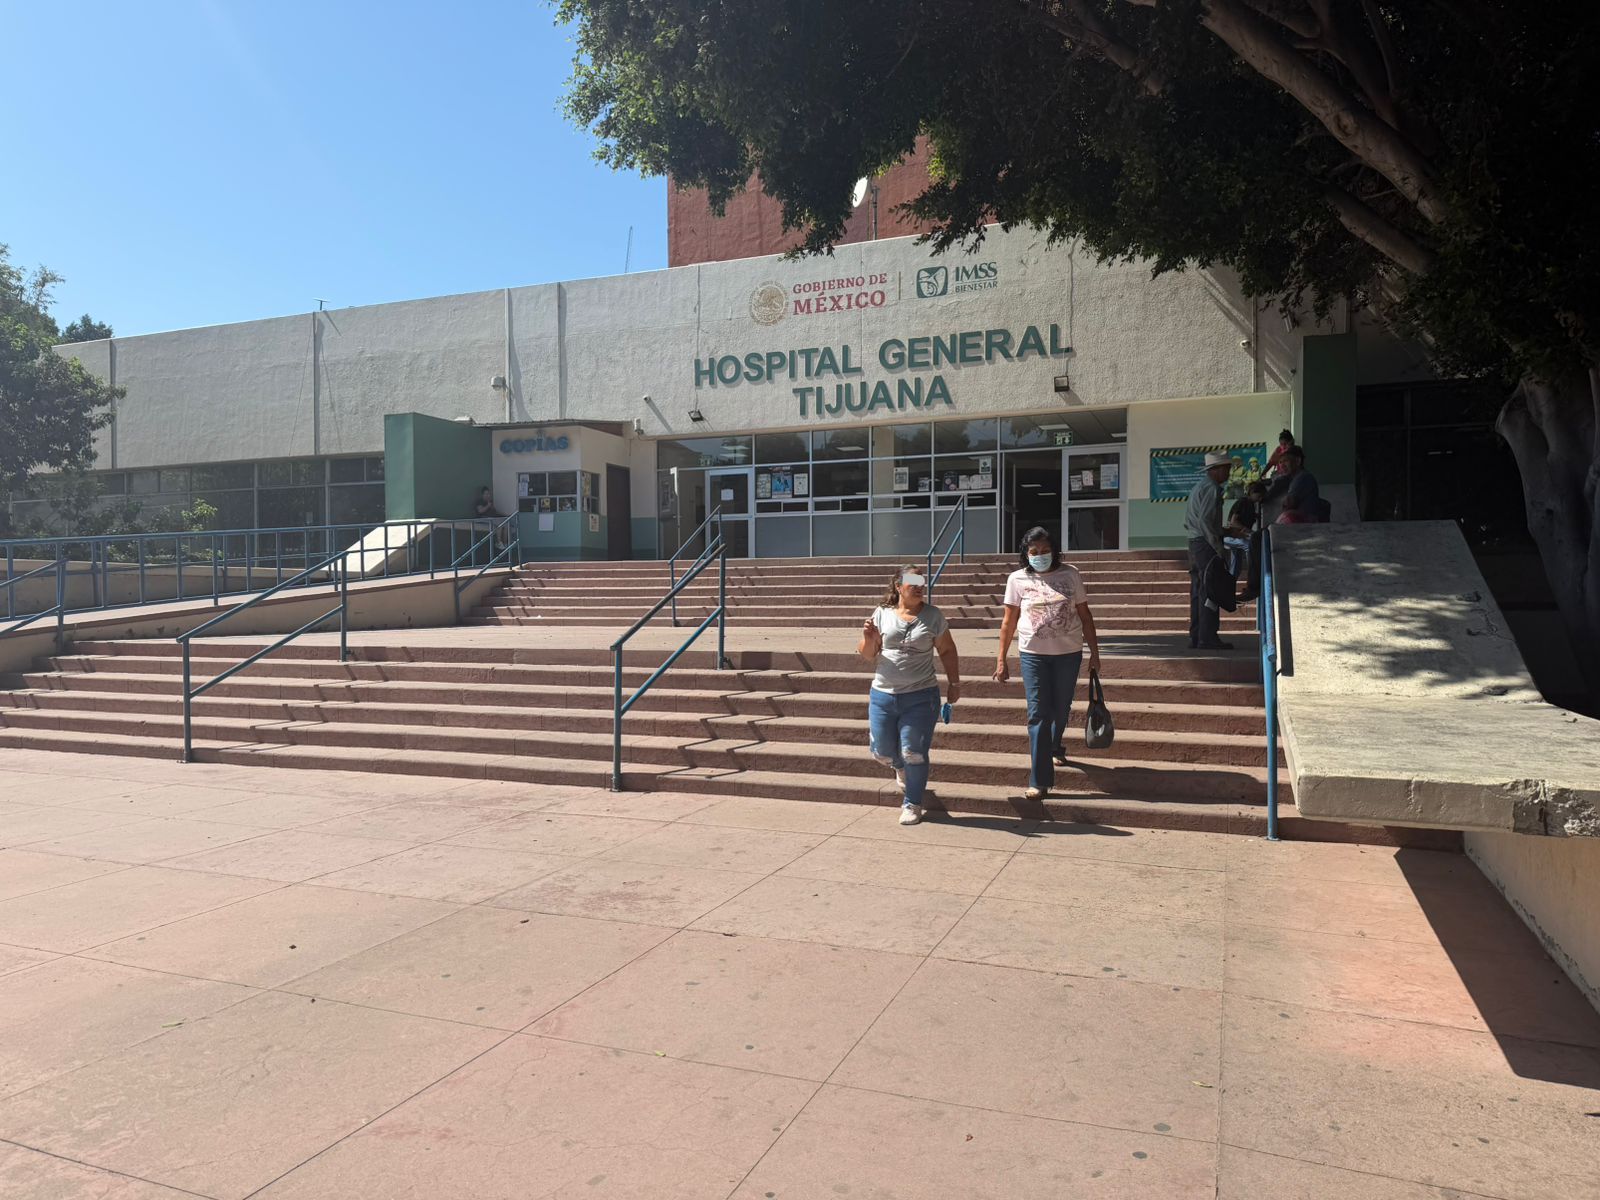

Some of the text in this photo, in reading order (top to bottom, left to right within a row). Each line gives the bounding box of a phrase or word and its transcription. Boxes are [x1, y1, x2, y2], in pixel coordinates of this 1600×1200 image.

[792, 273, 888, 294] GOBIERNO DE
[955, 262, 998, 282] IMSS
[955, 281, 998, 293] BIENESTAR
[792, 291, 886, 316] MÉXICO
[694, 323, 1073, 387] HOSPITAL GENERAL
[792, 375, 953, 417] TIJUANA
